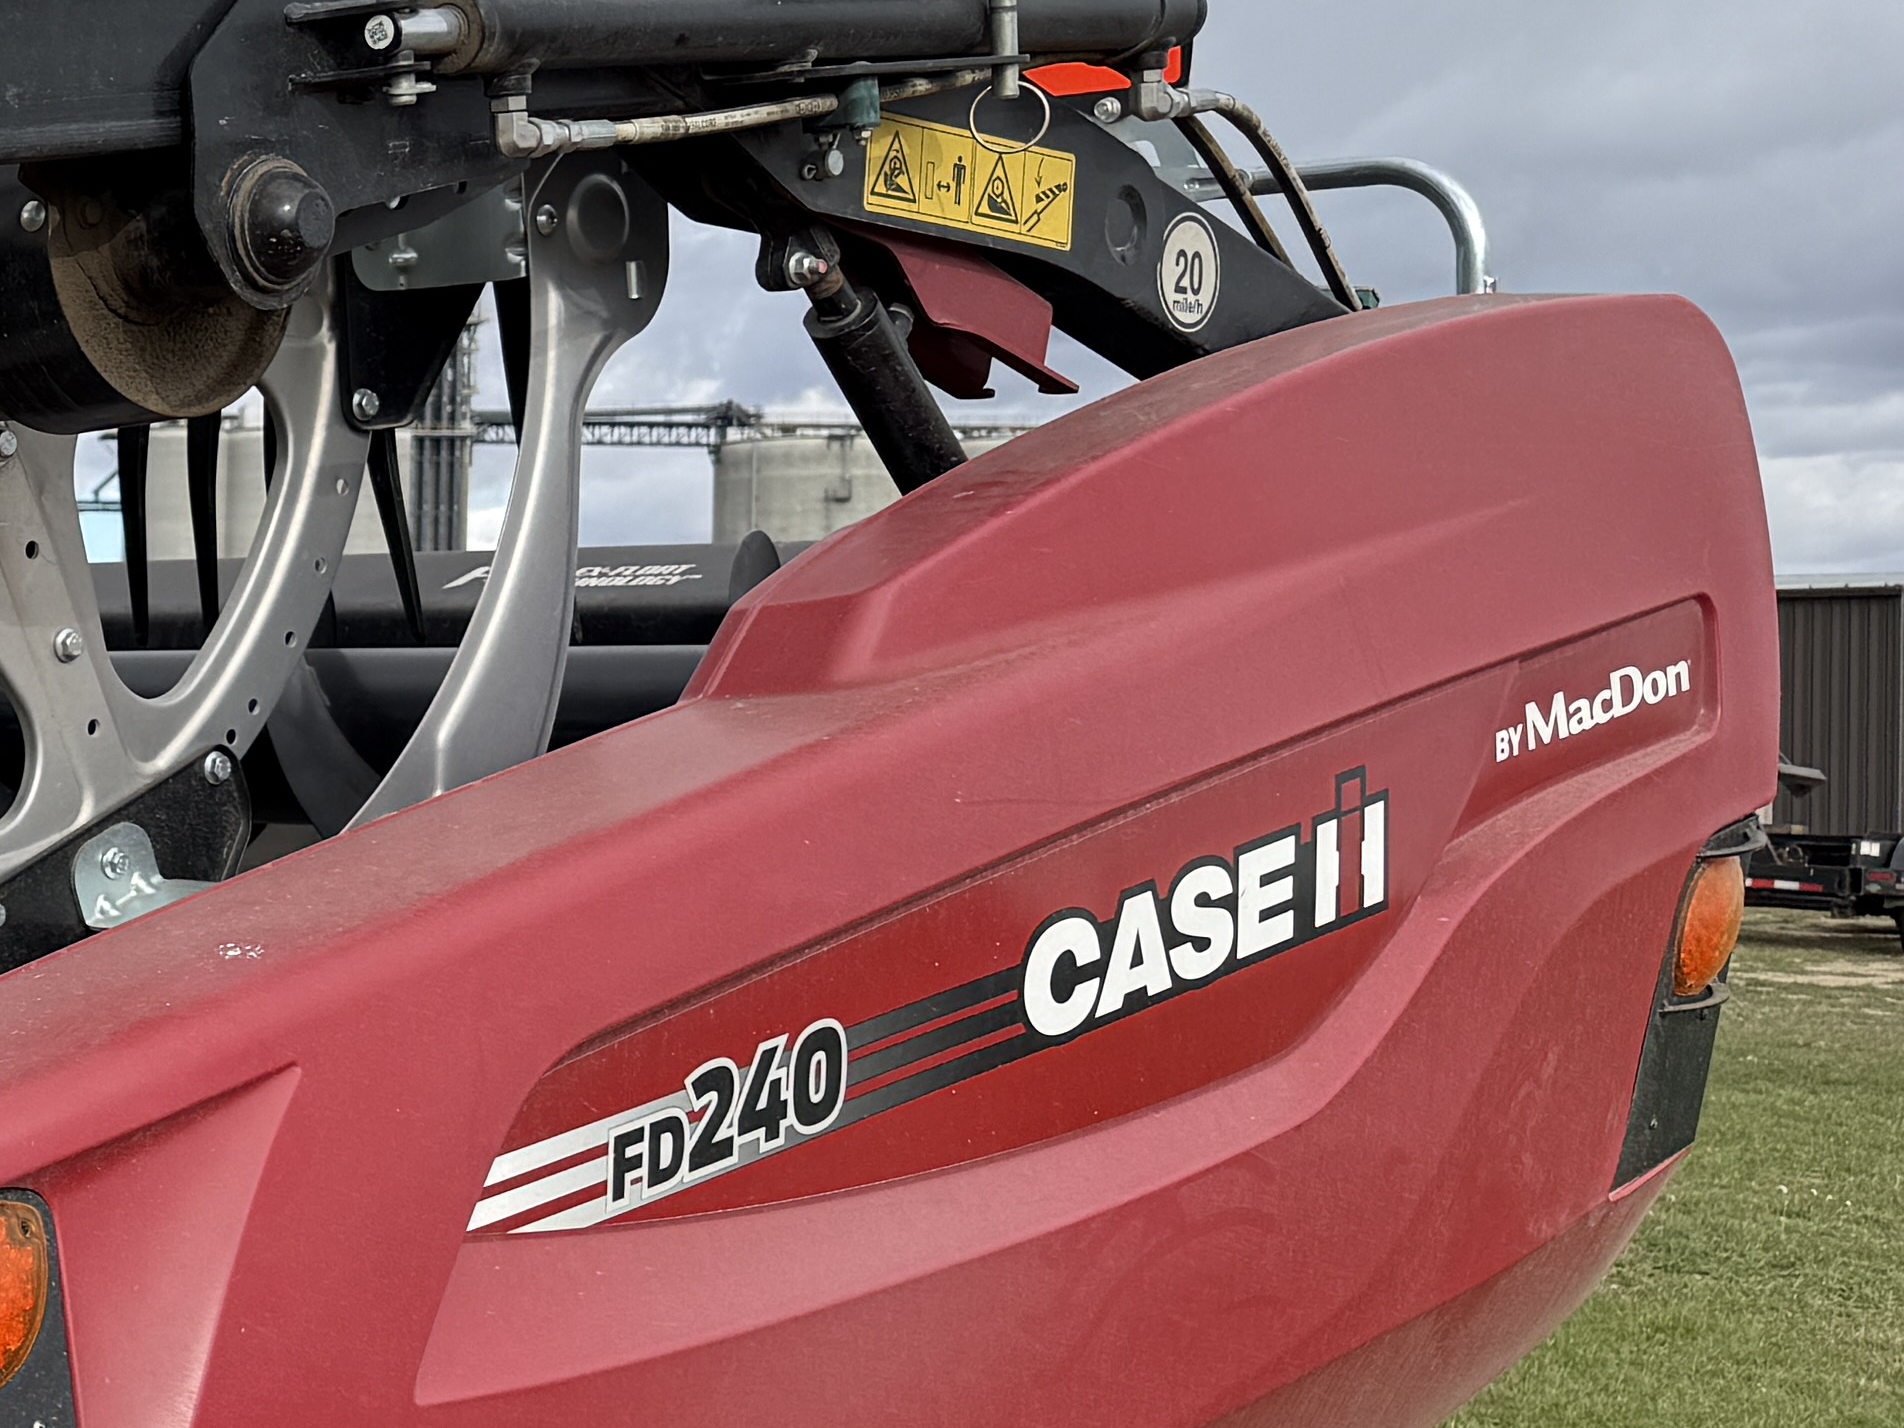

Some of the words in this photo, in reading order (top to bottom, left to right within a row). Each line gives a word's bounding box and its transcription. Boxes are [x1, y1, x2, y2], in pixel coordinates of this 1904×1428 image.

[1173, 248, 1204, 296] 20
[1495, 723, 1524, 763] BY
[1524, 659, 1692, 752] MacDon
[1023, 833, 1297, 1038] CASE
[607, 1019, 848, 1210] FD240
